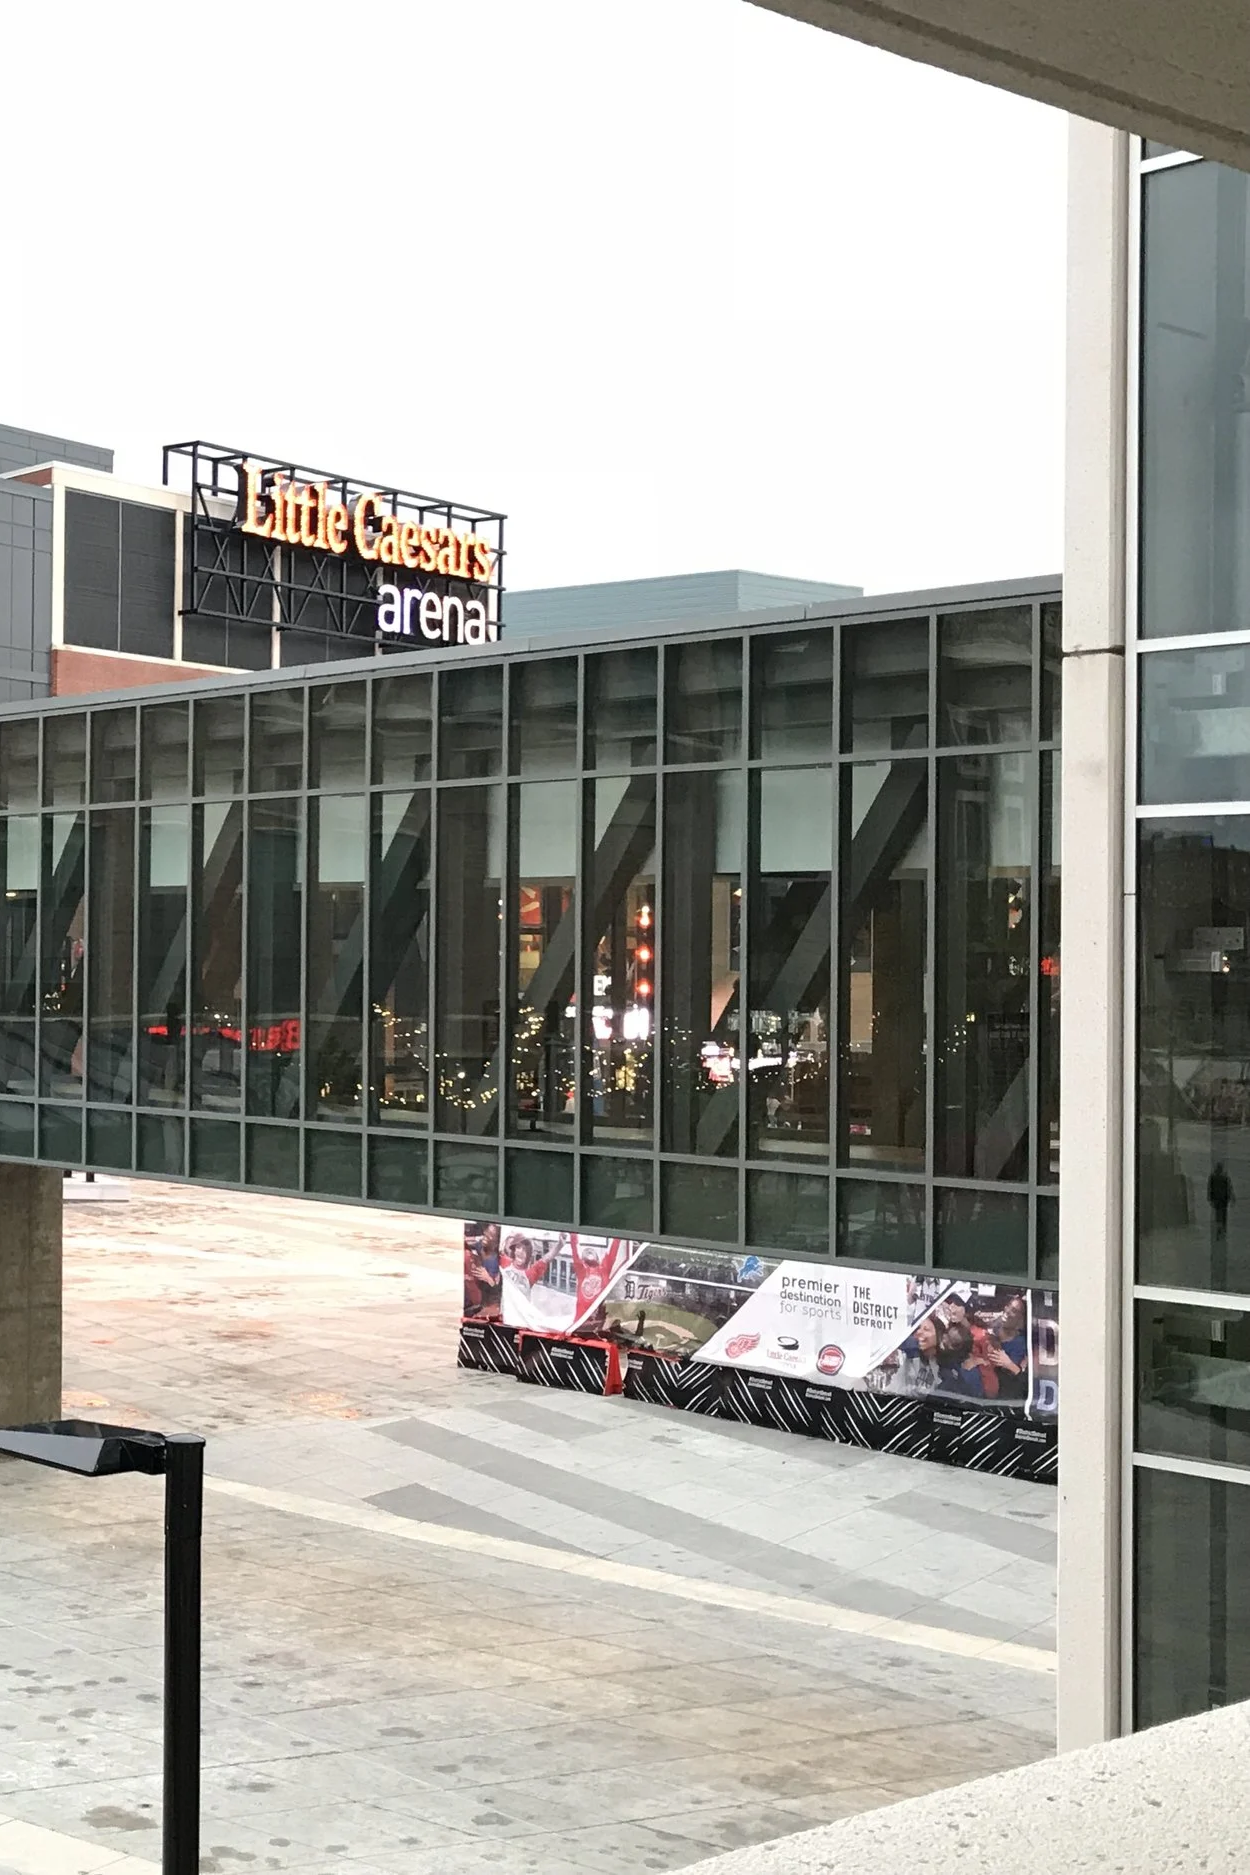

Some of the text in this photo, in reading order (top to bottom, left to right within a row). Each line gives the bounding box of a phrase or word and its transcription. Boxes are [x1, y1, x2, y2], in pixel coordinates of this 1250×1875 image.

[236, 461, 491, 582] Little Caesars
[377, 583, 489, 646] arena
[781, 1276, 840, 1294] premier
[853, 1285, 871, 1300] THE
[780, 1289, 841, 1307] destination
[780, 1302, 842, 1320] for sports
[853, 1301, 898, 1319] DISTRICT
[853, 1317, 894, 1330] DETROIT
